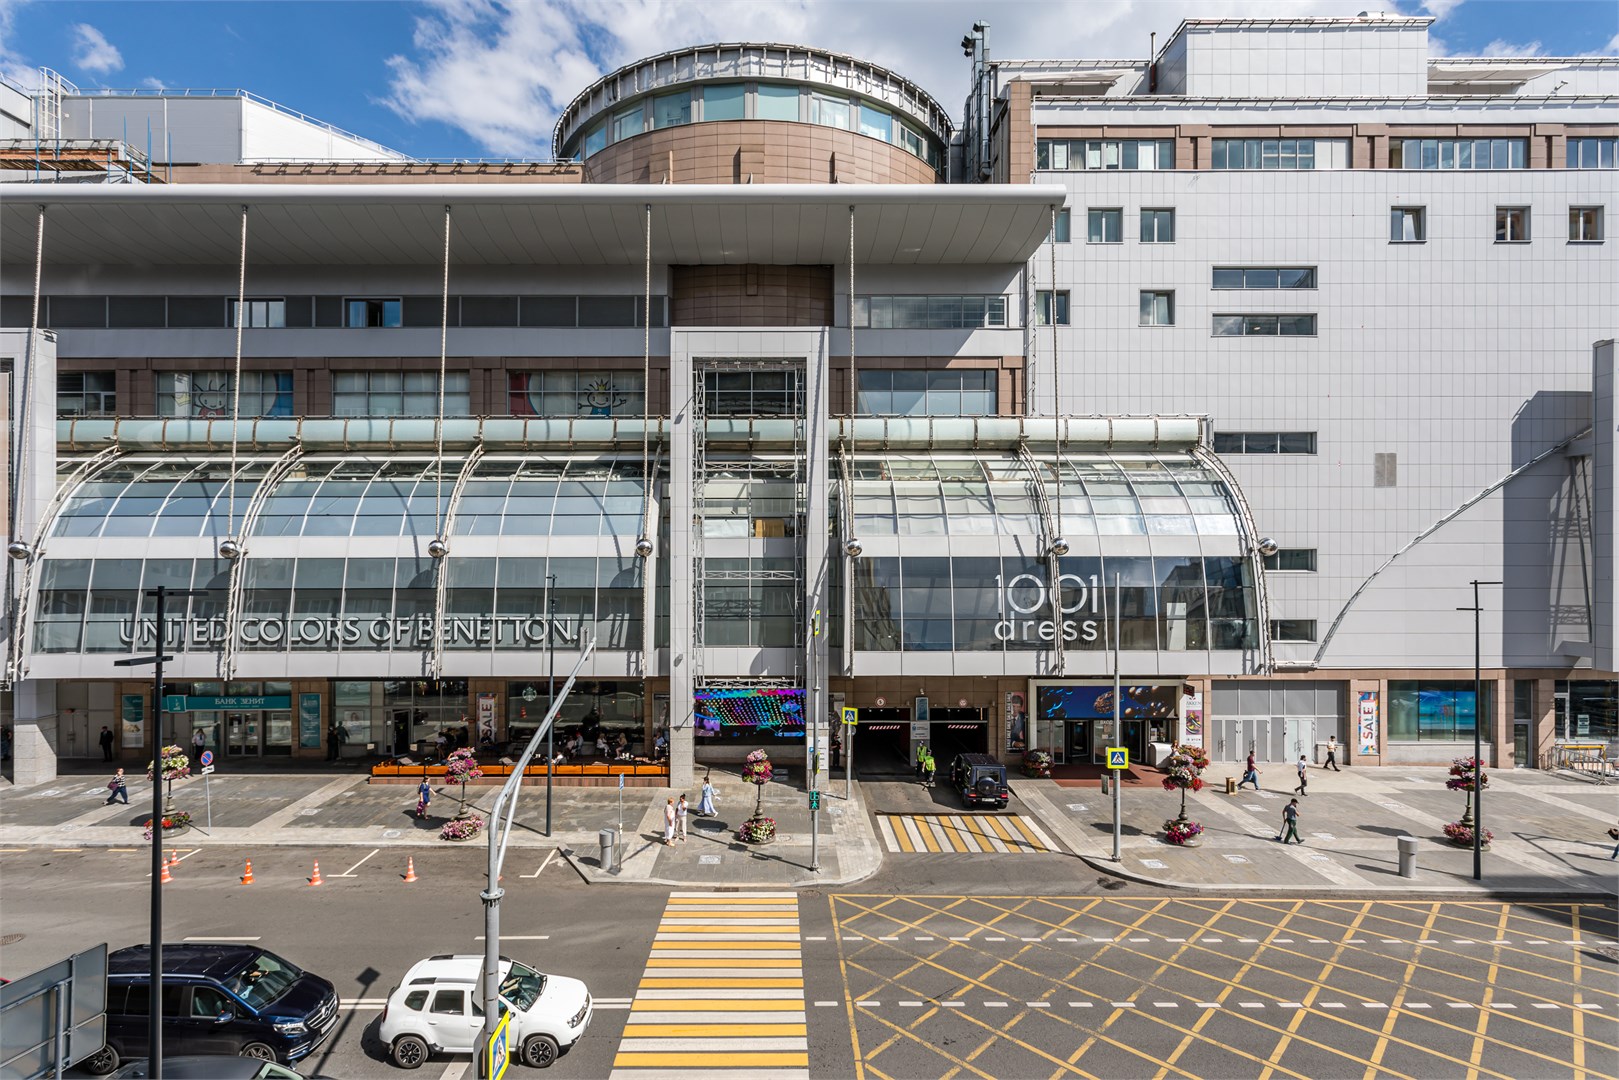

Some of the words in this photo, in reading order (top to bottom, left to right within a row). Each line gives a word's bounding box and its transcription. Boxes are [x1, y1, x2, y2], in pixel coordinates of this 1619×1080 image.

[994, 574, 1098, 614] 1001
[120, 617, 228, 642] UNITED
[239, 617, 361, 643] COLORS
[369, 617, 410, 641] OF
[994, 611, 1098, 641] dress
[481, 703, 493, 737] SALE
[1363, 706, 1374, 739] SALE
